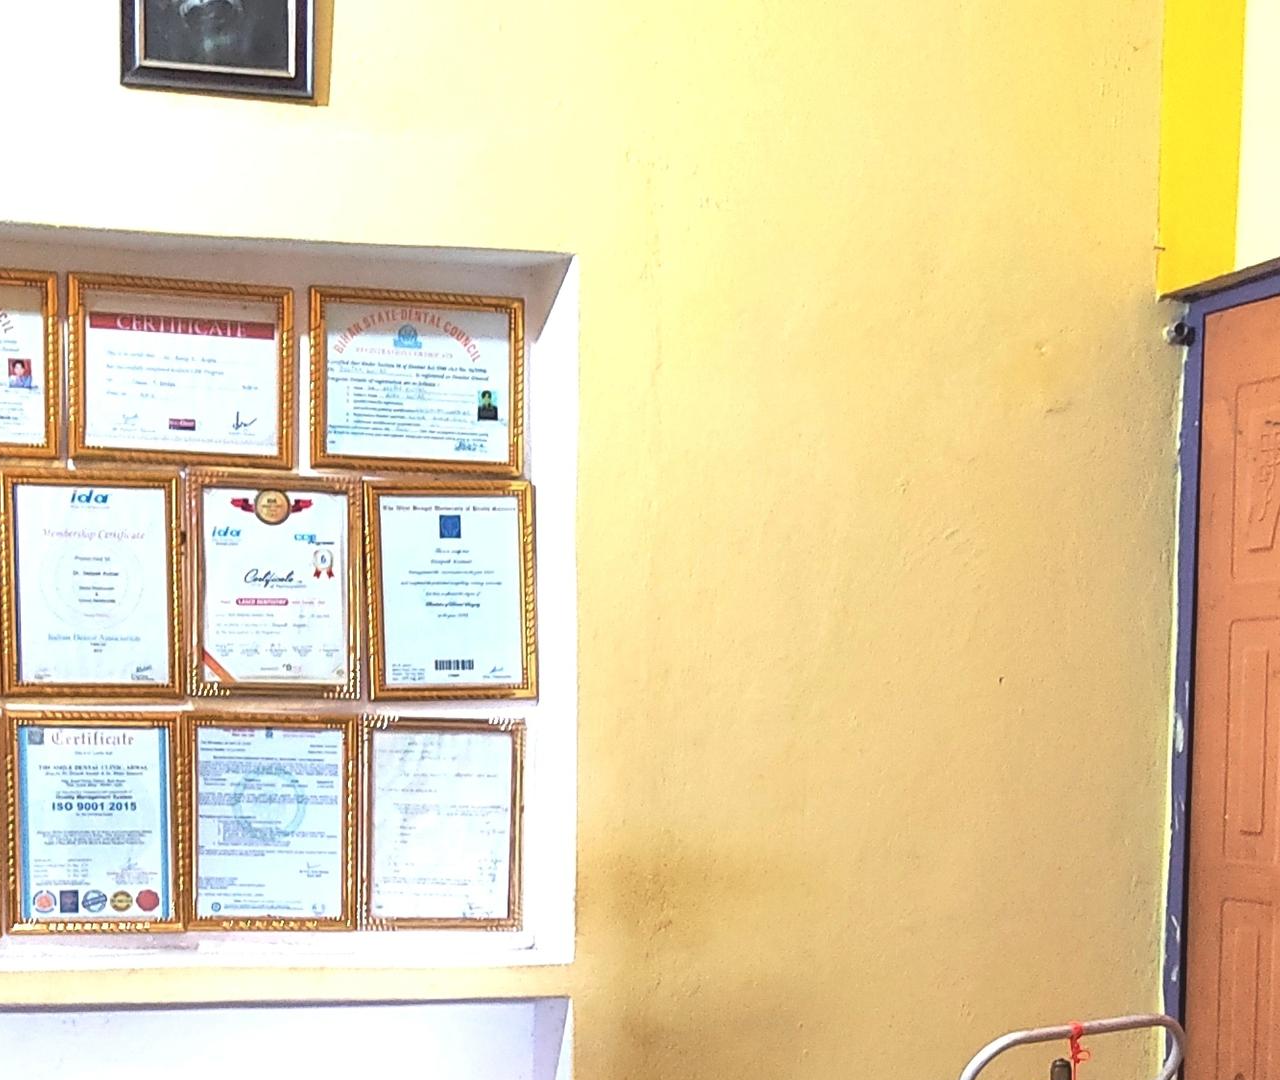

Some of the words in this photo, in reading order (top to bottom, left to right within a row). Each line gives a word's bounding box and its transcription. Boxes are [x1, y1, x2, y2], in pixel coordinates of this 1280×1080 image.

[116, 314, 247, 338] CERTIFICATE
[363, 309, 396, 330] STATE
[401, 309, 440, 328] DENTAL
[443, 321, 480, 362] COUNCIL
[244, 568, 295, 588] Certificate
[51, 731, 134, 746] Certificate
[52, 802, 73, 811] ISO
[77, 802, 105, 811] 9001
[109, 802, 137, 811] 2015
